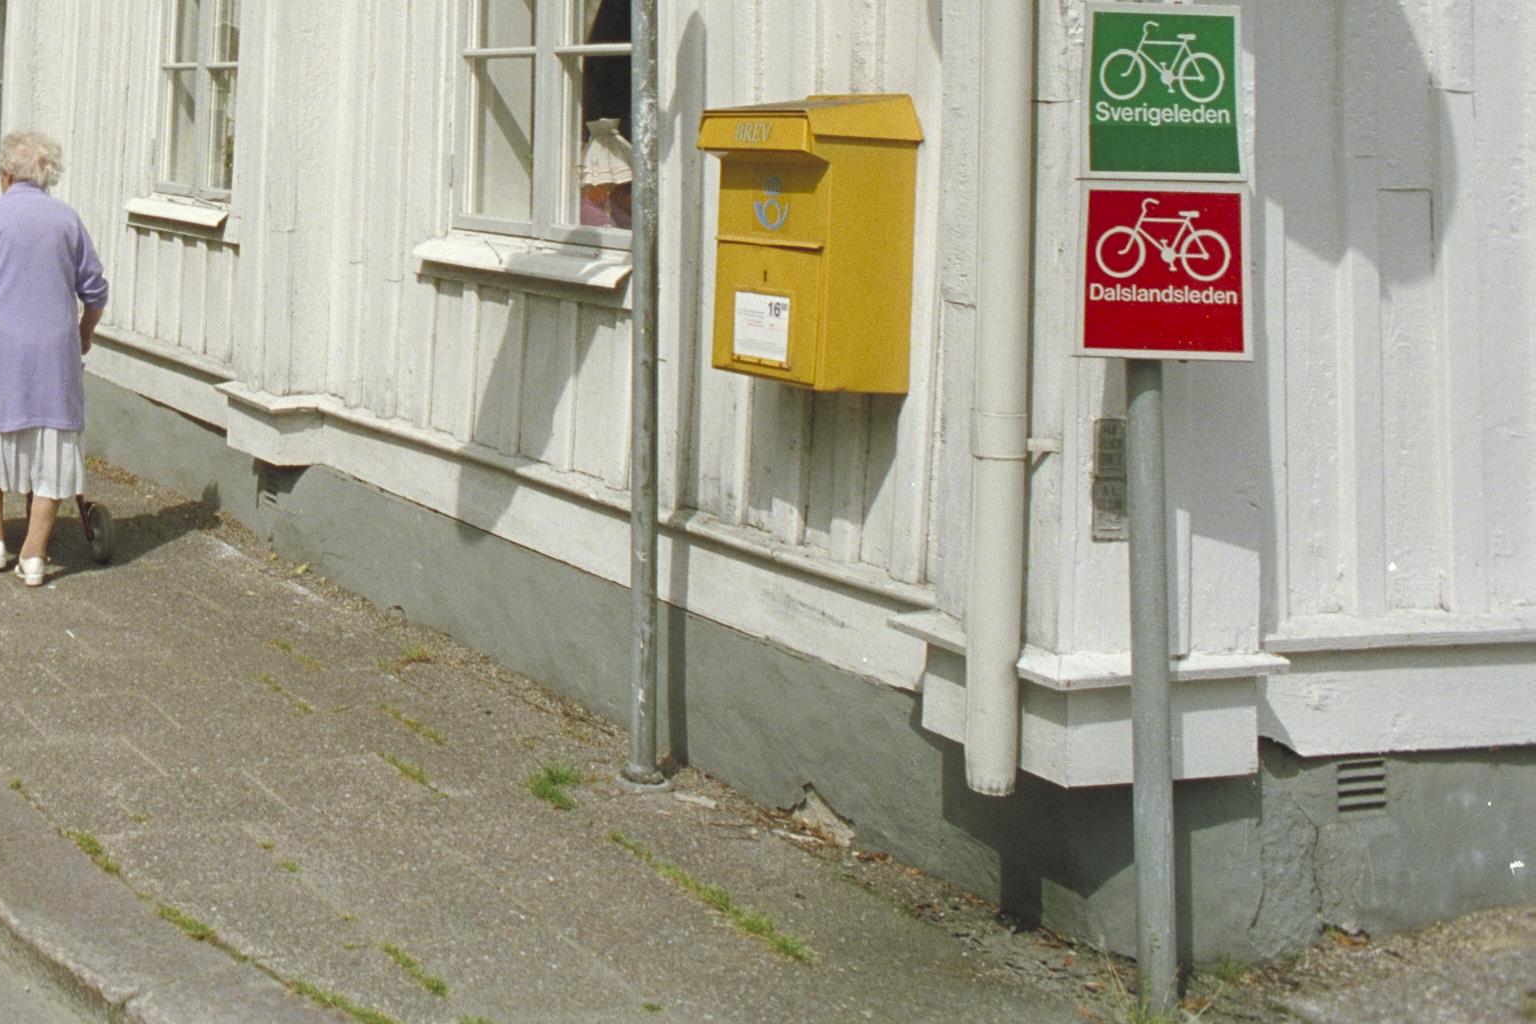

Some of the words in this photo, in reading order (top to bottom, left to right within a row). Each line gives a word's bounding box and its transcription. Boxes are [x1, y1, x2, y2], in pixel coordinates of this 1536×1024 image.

[1095, 100, 1231, 127] Sverigeleden
[735, 121, 772, 144] BREV
[1089, 282, 1239, 305] Dalslandsleden
